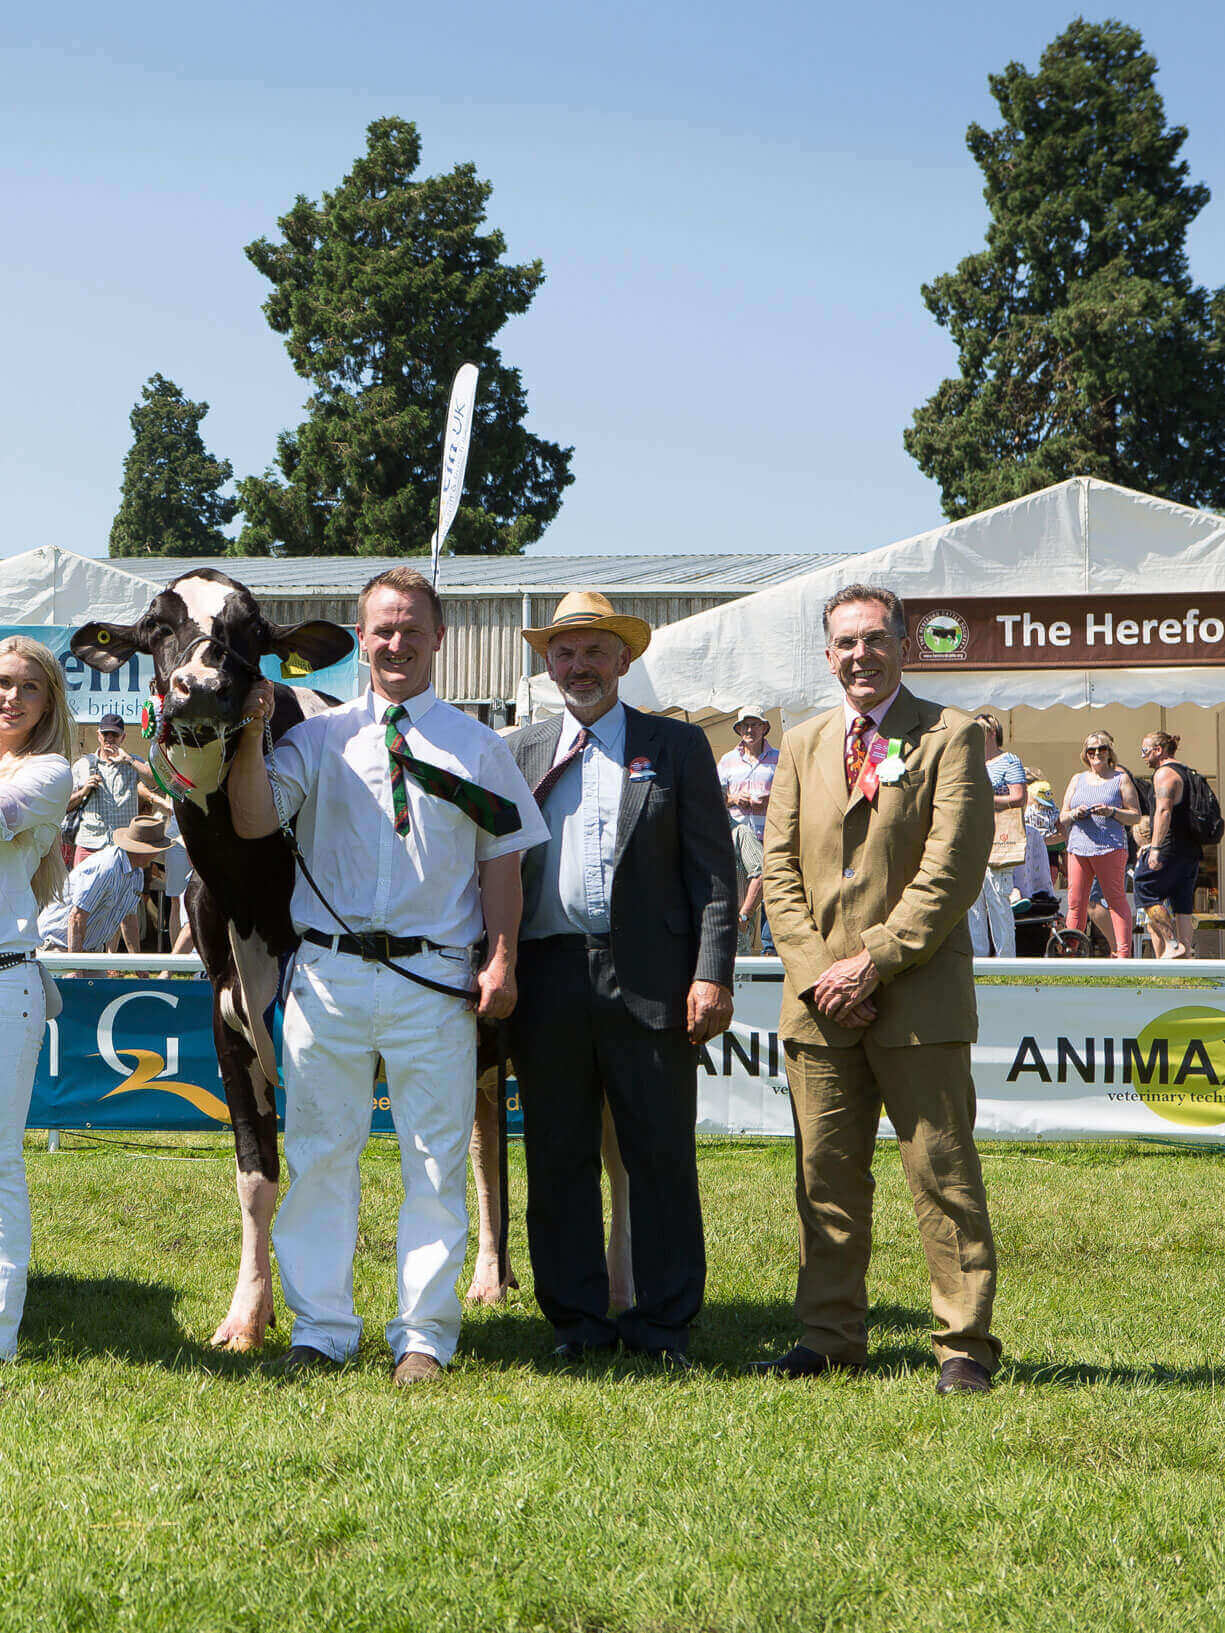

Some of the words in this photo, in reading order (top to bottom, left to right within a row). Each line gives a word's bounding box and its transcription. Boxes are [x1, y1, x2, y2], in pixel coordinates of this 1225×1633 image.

[995, 612, 1072, 648] The
[1085, 608, 1225, 646] Herefo
[1005, 1036, 1225, 1086] ANIMA
[1107, 1092, 1187, 1106] veterinary
[1190, 1090, 1225, 1103] tech
